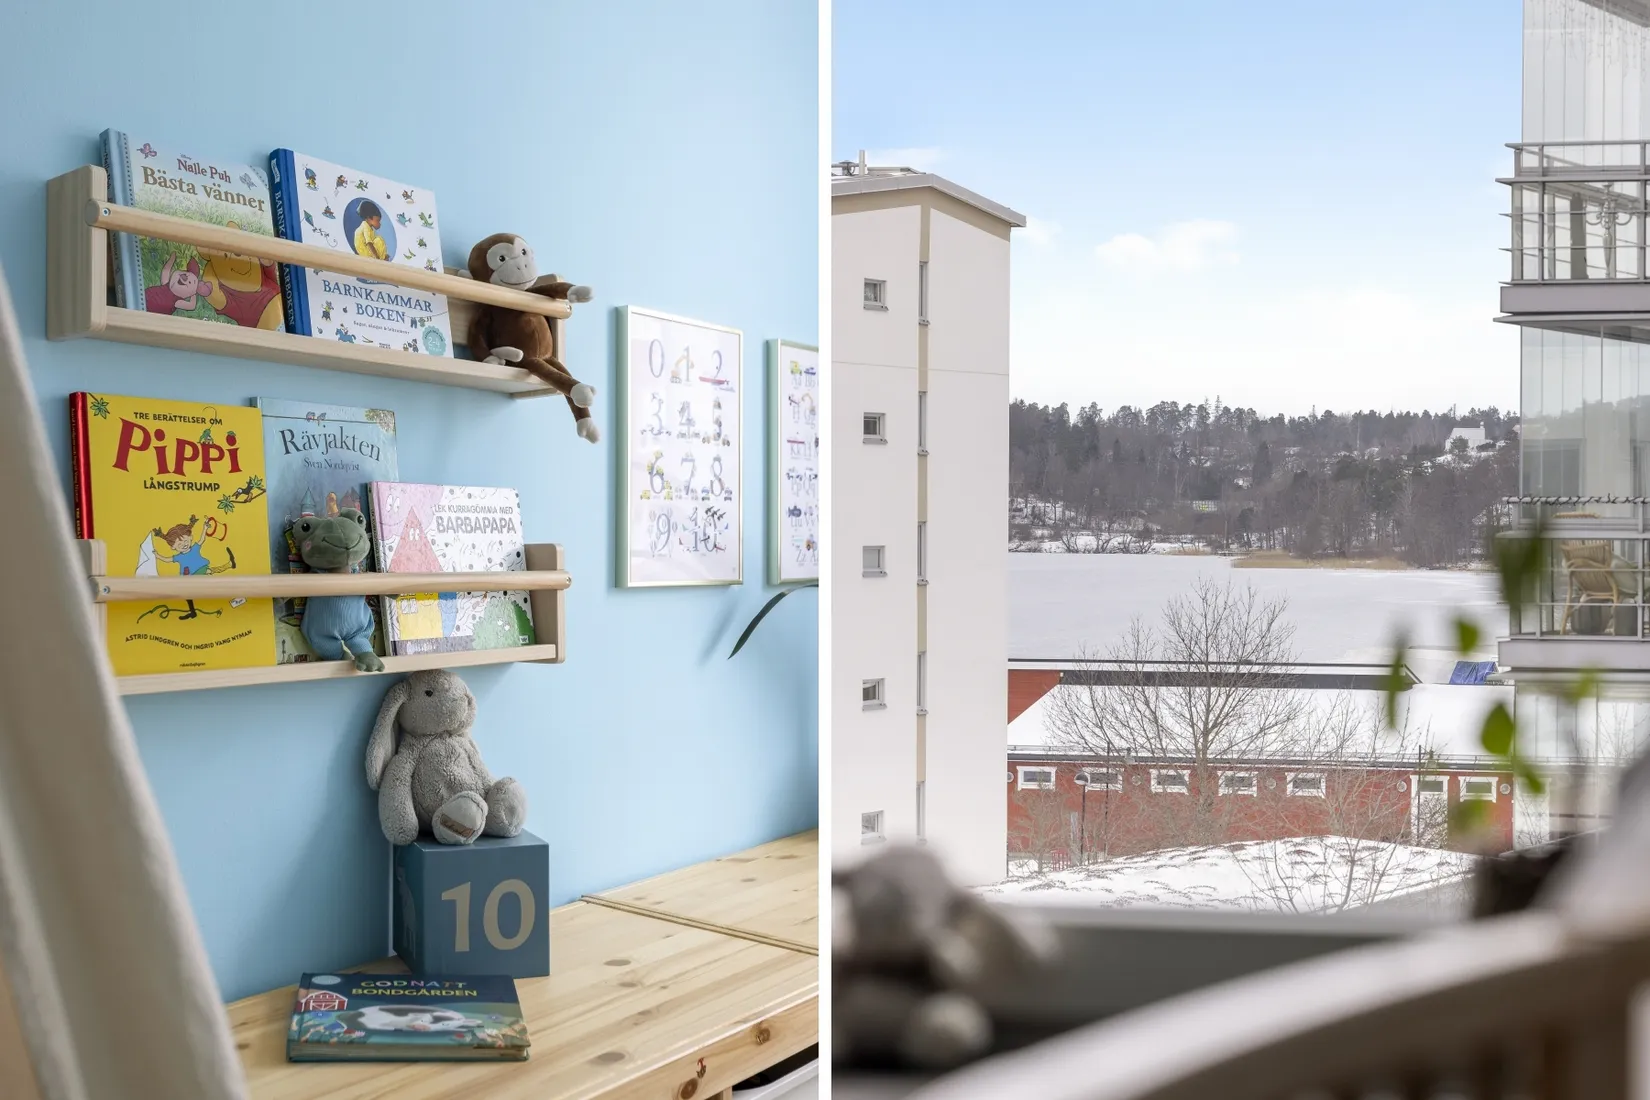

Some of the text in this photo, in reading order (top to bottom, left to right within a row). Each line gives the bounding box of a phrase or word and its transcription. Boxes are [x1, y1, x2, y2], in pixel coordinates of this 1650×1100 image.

[177, 158, 231, 184] Nalle Puh
[141, 166, 265, 213] Bästa vänner
[322, 279, 433, 313] BARNKAMMAR
[356, 303, 406, 324] BOKEN
[649, 338, 723, 386] 0 1 2
[133, 411, 150, 421] TRE
[152, 413, 206, 425] BERÄTTELSER
[651, 393, 723, 441] 3 4 5
[279, 424, 381, 462] Rävjakten
[303, 456, 360, 472] Sven Nordqvist
[650, 453, 724, 497] 6 7 8
[143, 477, 220, 492] LÅNGSTRUMP
[434, 503, 513, 515] LEK KURRAGÖMMA MED
[435, 515, 517, 534] BARBAPAPA
[656, 513, 670, 552] 9
[125, 630, 253, 650] ASTRID LINDGREN OCH INGRID VANG NYMAN
[441, 878, 536, 953] 10
[351, 987, 478, 997] BONDGÅRDEN
